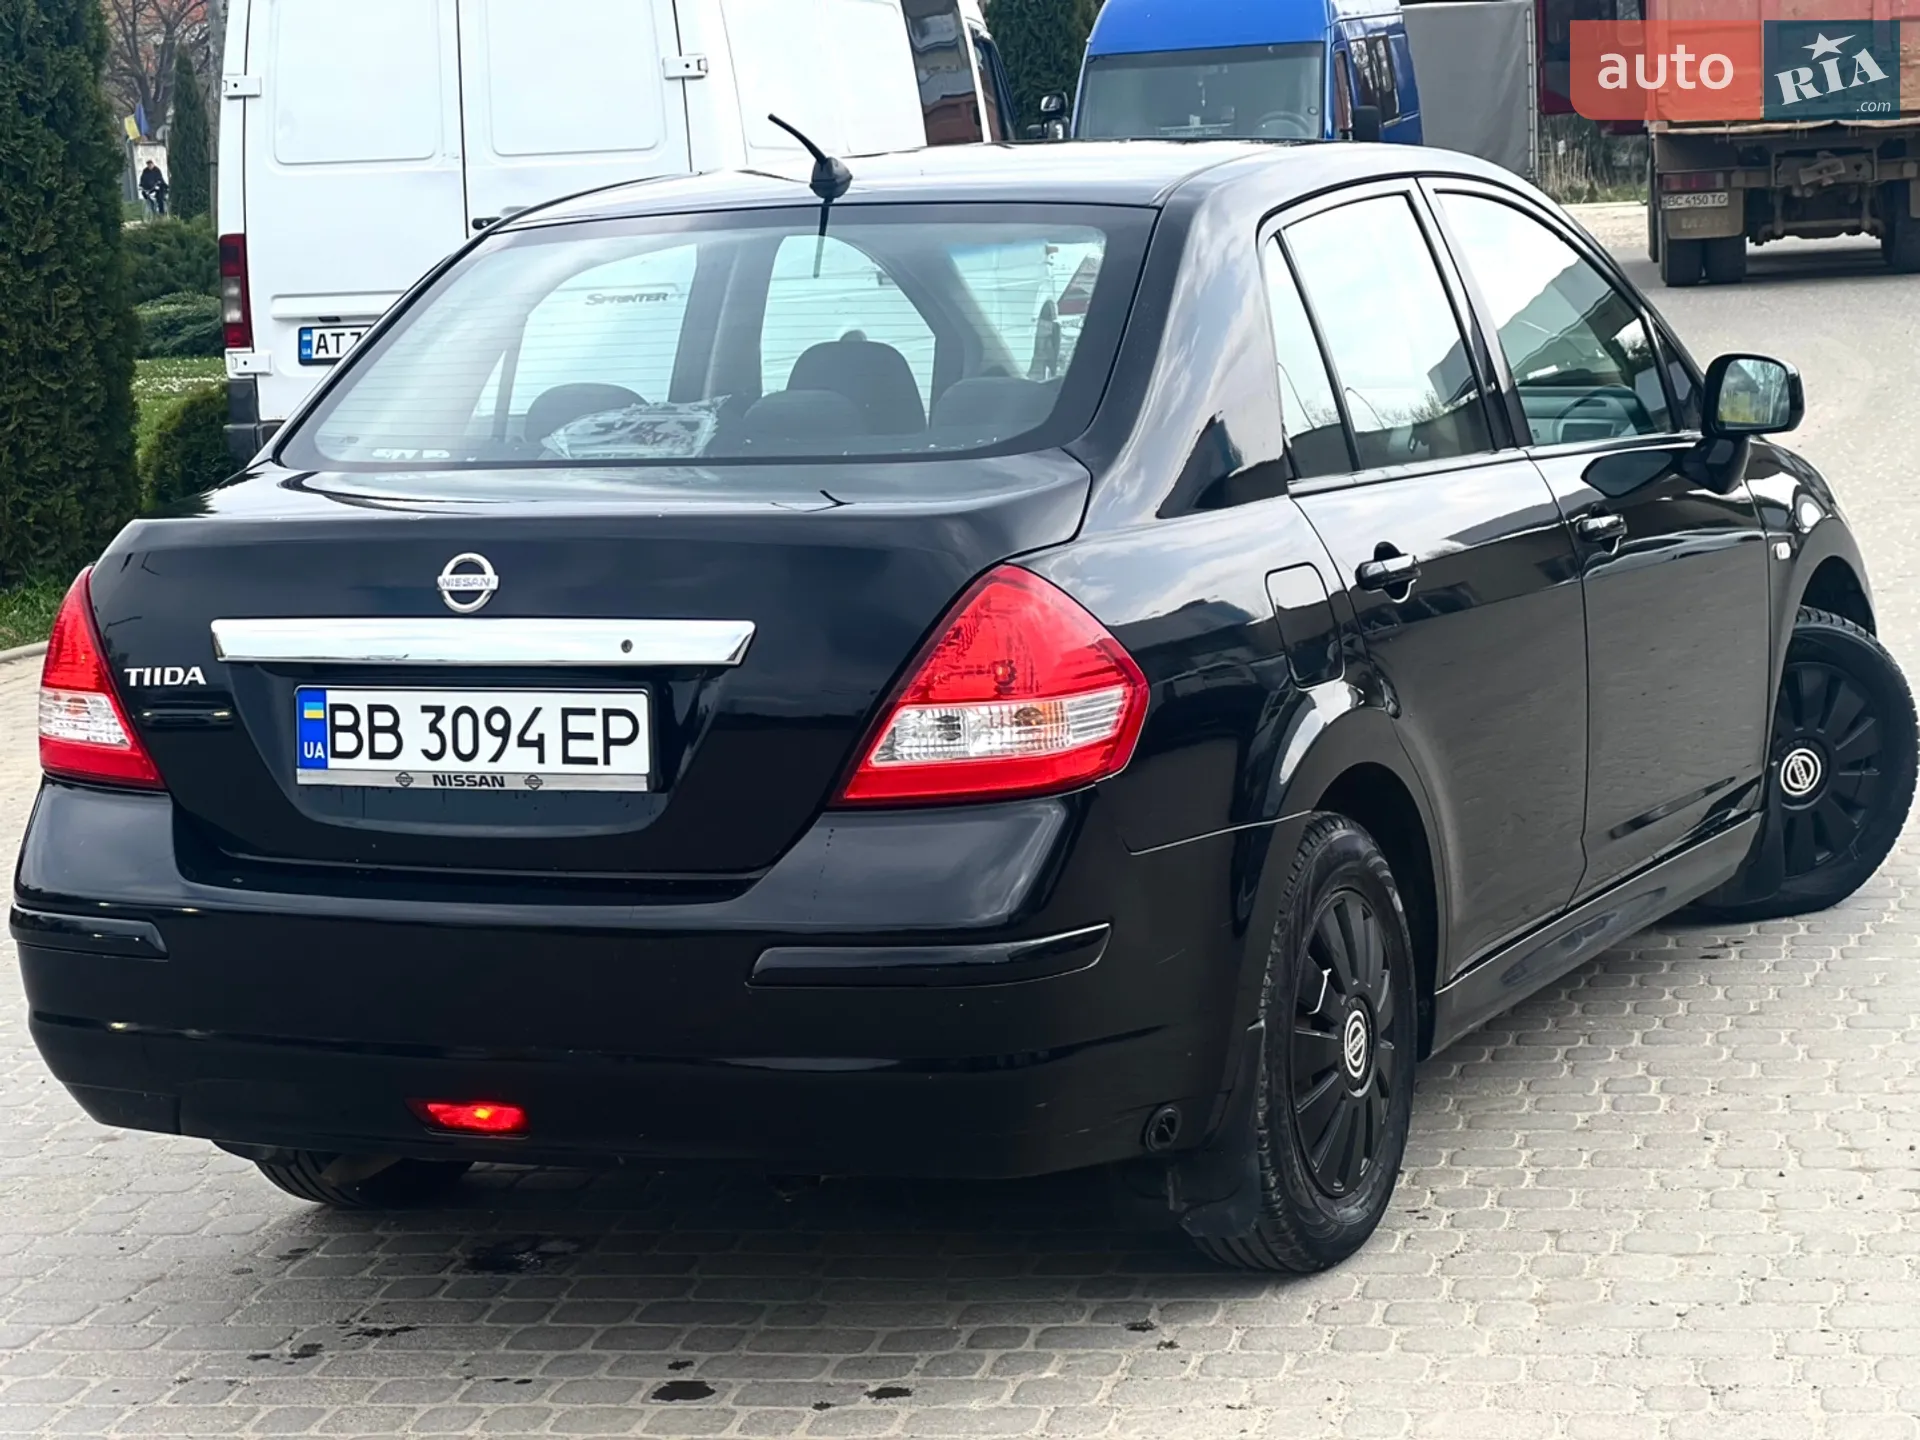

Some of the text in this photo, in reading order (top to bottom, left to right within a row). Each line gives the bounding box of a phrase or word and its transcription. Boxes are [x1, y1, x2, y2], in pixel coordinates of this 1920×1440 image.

[1667, 195, 1683, 206] BC
[315, 332, 345, 355] AT
[441, 577, 491, 587] NISSAN
[123, 666, 207, 687] TIIDA
[329, 703, 640, 766] BB 3094 EP
[303, 741, 325, 759] UA
[432, 774, 506, 788] NISSAN
